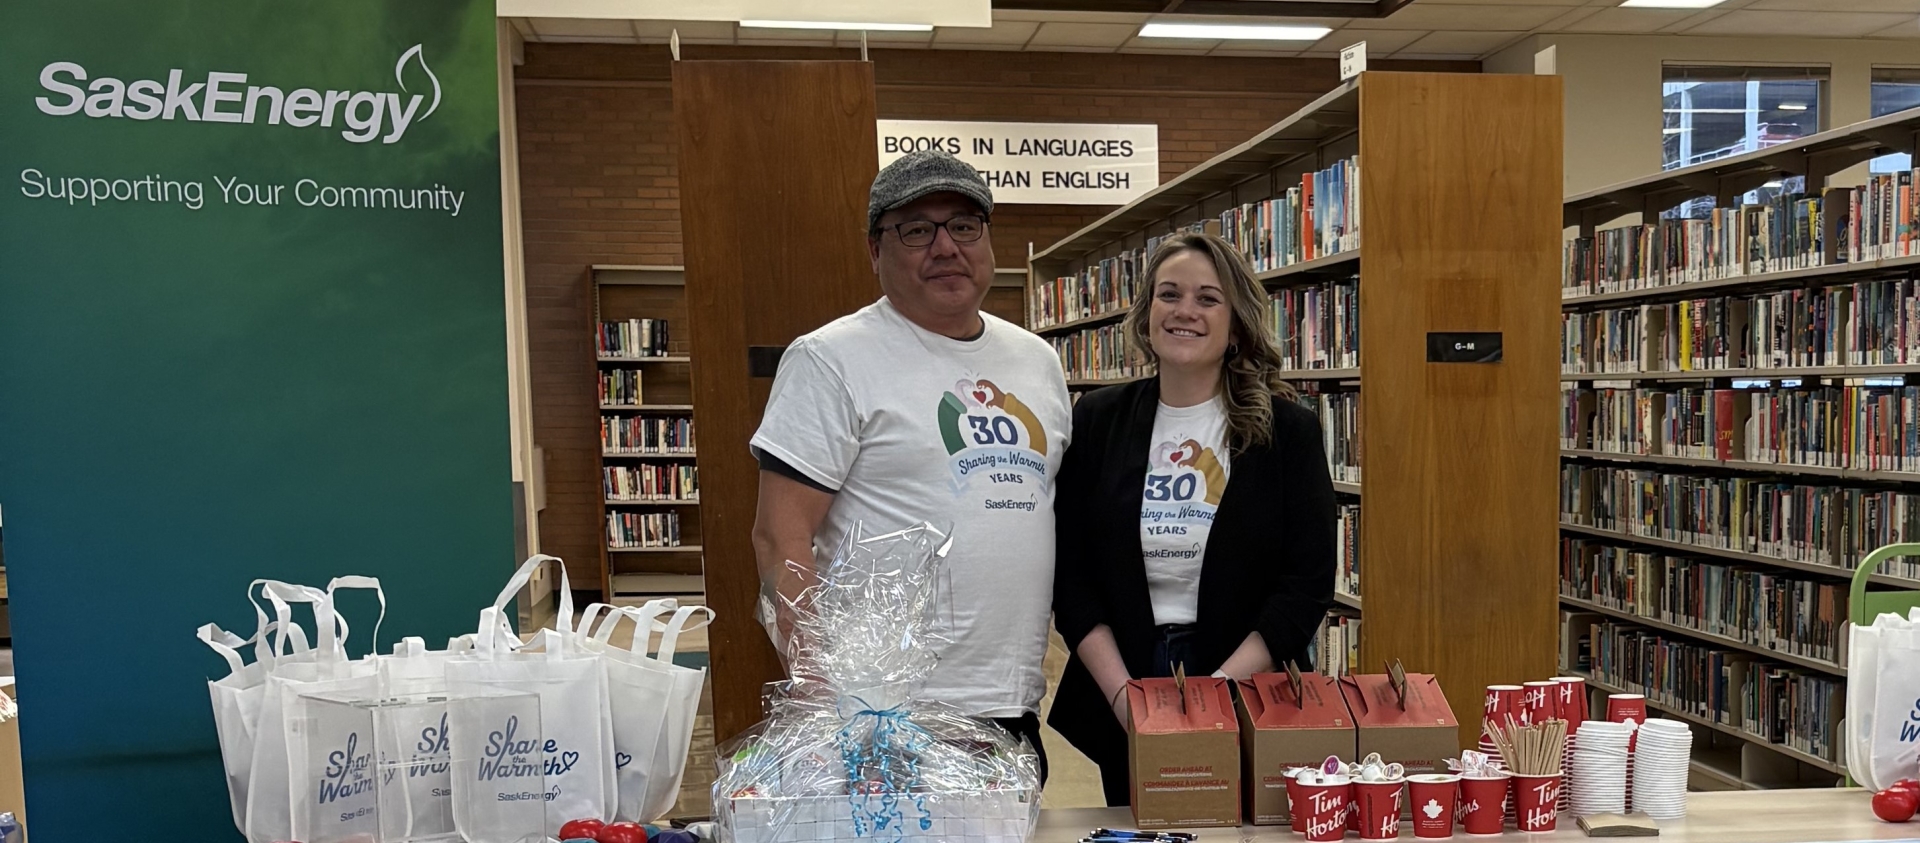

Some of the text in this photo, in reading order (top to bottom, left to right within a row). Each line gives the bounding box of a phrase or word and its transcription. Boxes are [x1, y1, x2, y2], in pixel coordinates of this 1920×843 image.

[35, 61, 424, 144] SaskEnergy
[884, 136, 1134, 157] BOOKS IN LANGUAGES
[1042, 171, 1130, 189] ENGLISH
[20, 168, 465, 216] Supporting Your Community
[1454, 342, 1475, 350] G-M
[967, 415, 1018, 445] 30
[958, 453, 996, 475] Sharing
[1009, 451, 1046, 475] Warmth
[989, 473, 1023, 484] YEARS
[1144, 473, 1196, 501] 30
[985, 499, 1036, 511] SaskEnergy
[1178, 505, 1216, 520] Warm
[1147, 525, 1187, 535] YEARS
[1143, 549, 1198, 559] askEnergy
[478, 756, 565, 781] Warmth
[512, 755, 526, 763] the
[1309, 790, 1341, 815] Tim
[1306, 808, 1348, 839] Horto
